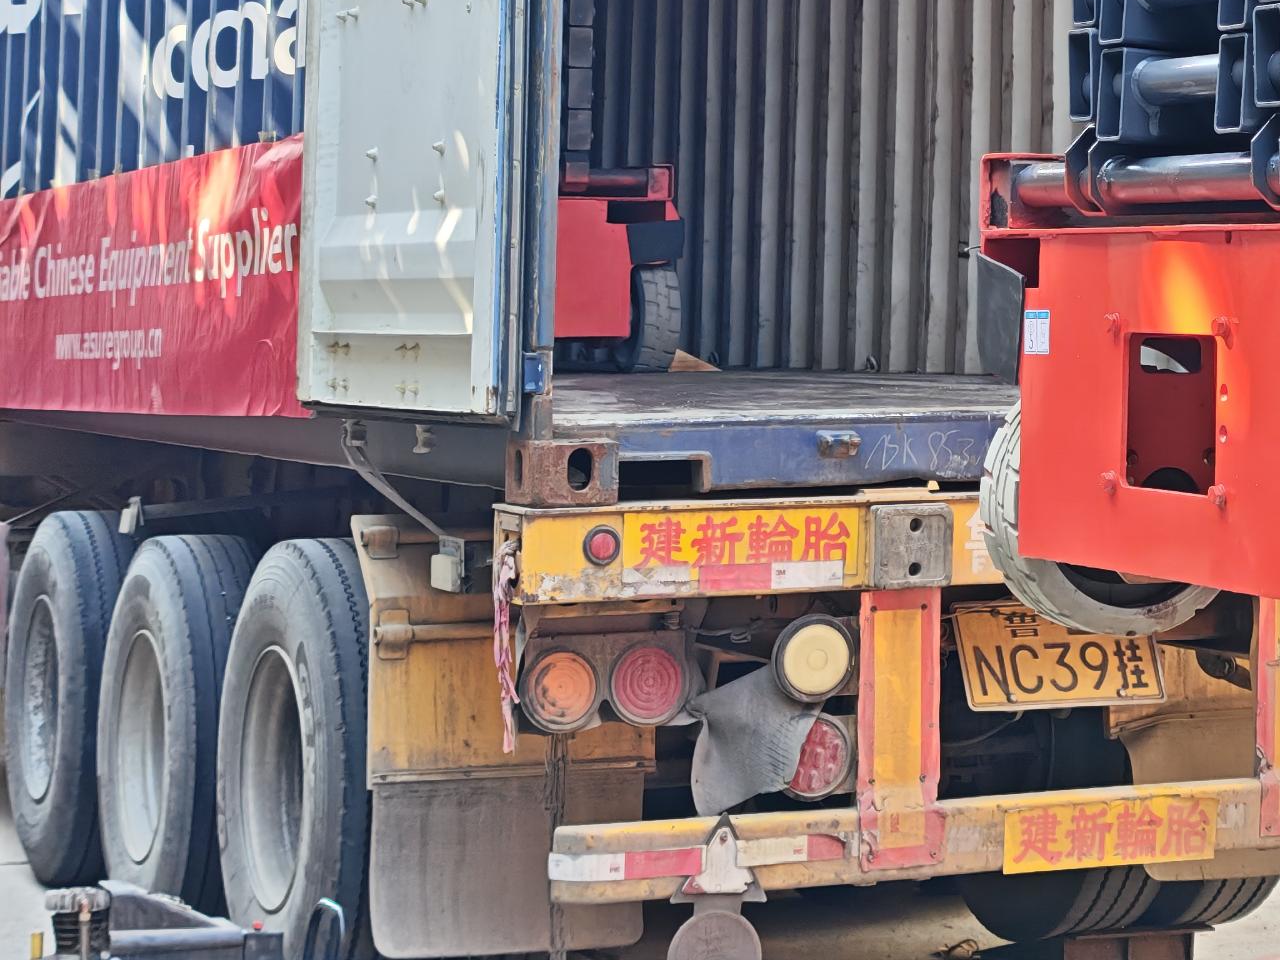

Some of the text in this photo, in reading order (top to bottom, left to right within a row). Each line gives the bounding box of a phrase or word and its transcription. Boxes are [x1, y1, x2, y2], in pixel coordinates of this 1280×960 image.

[0, 206, 298, 308] able Chinese Equipment Supplier
